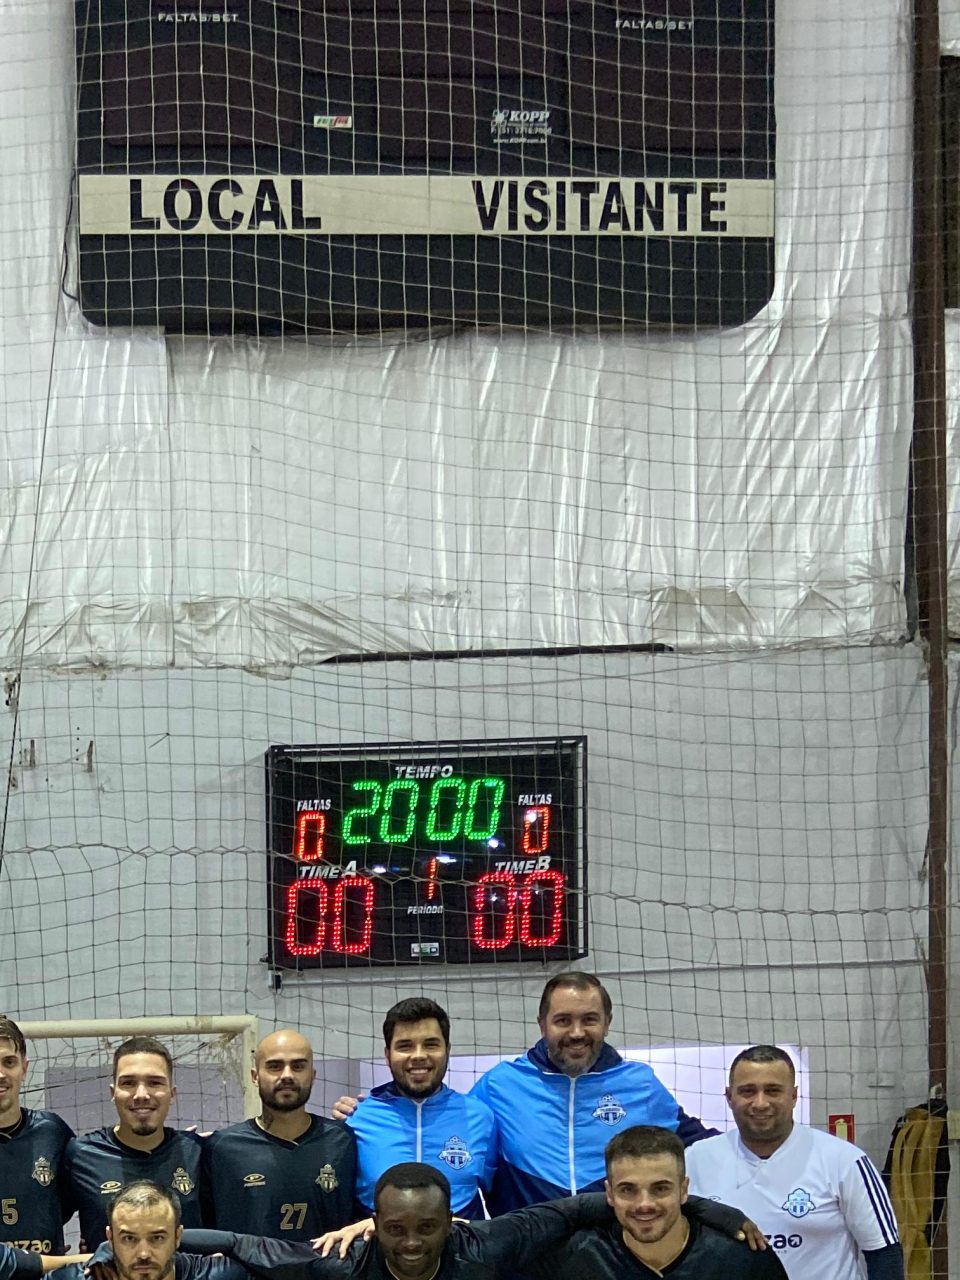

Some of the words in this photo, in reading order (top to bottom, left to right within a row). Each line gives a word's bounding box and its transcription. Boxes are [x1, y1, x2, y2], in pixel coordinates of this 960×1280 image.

[510, 110, 550, 122] KOPP
[130, 179, 321, 230] LOCAL
[472, 181, 727, 231] VISITANTE
[395, 764, 453, 779] TEMPO
[297, 799, 332, 812] FALTAS
[518, 793, 552, 806] FALTAS
[298, 813, 326, 861] 0
[523, 806, 549, 854] 0
[286, 878, 374, 956] 00
[407, 903, 444, 915] PERÍODO
[473, 870, 564, 949] 00
[1, 1198, 19, 1226] 5
[280, 1203, 308, 1230] 27
